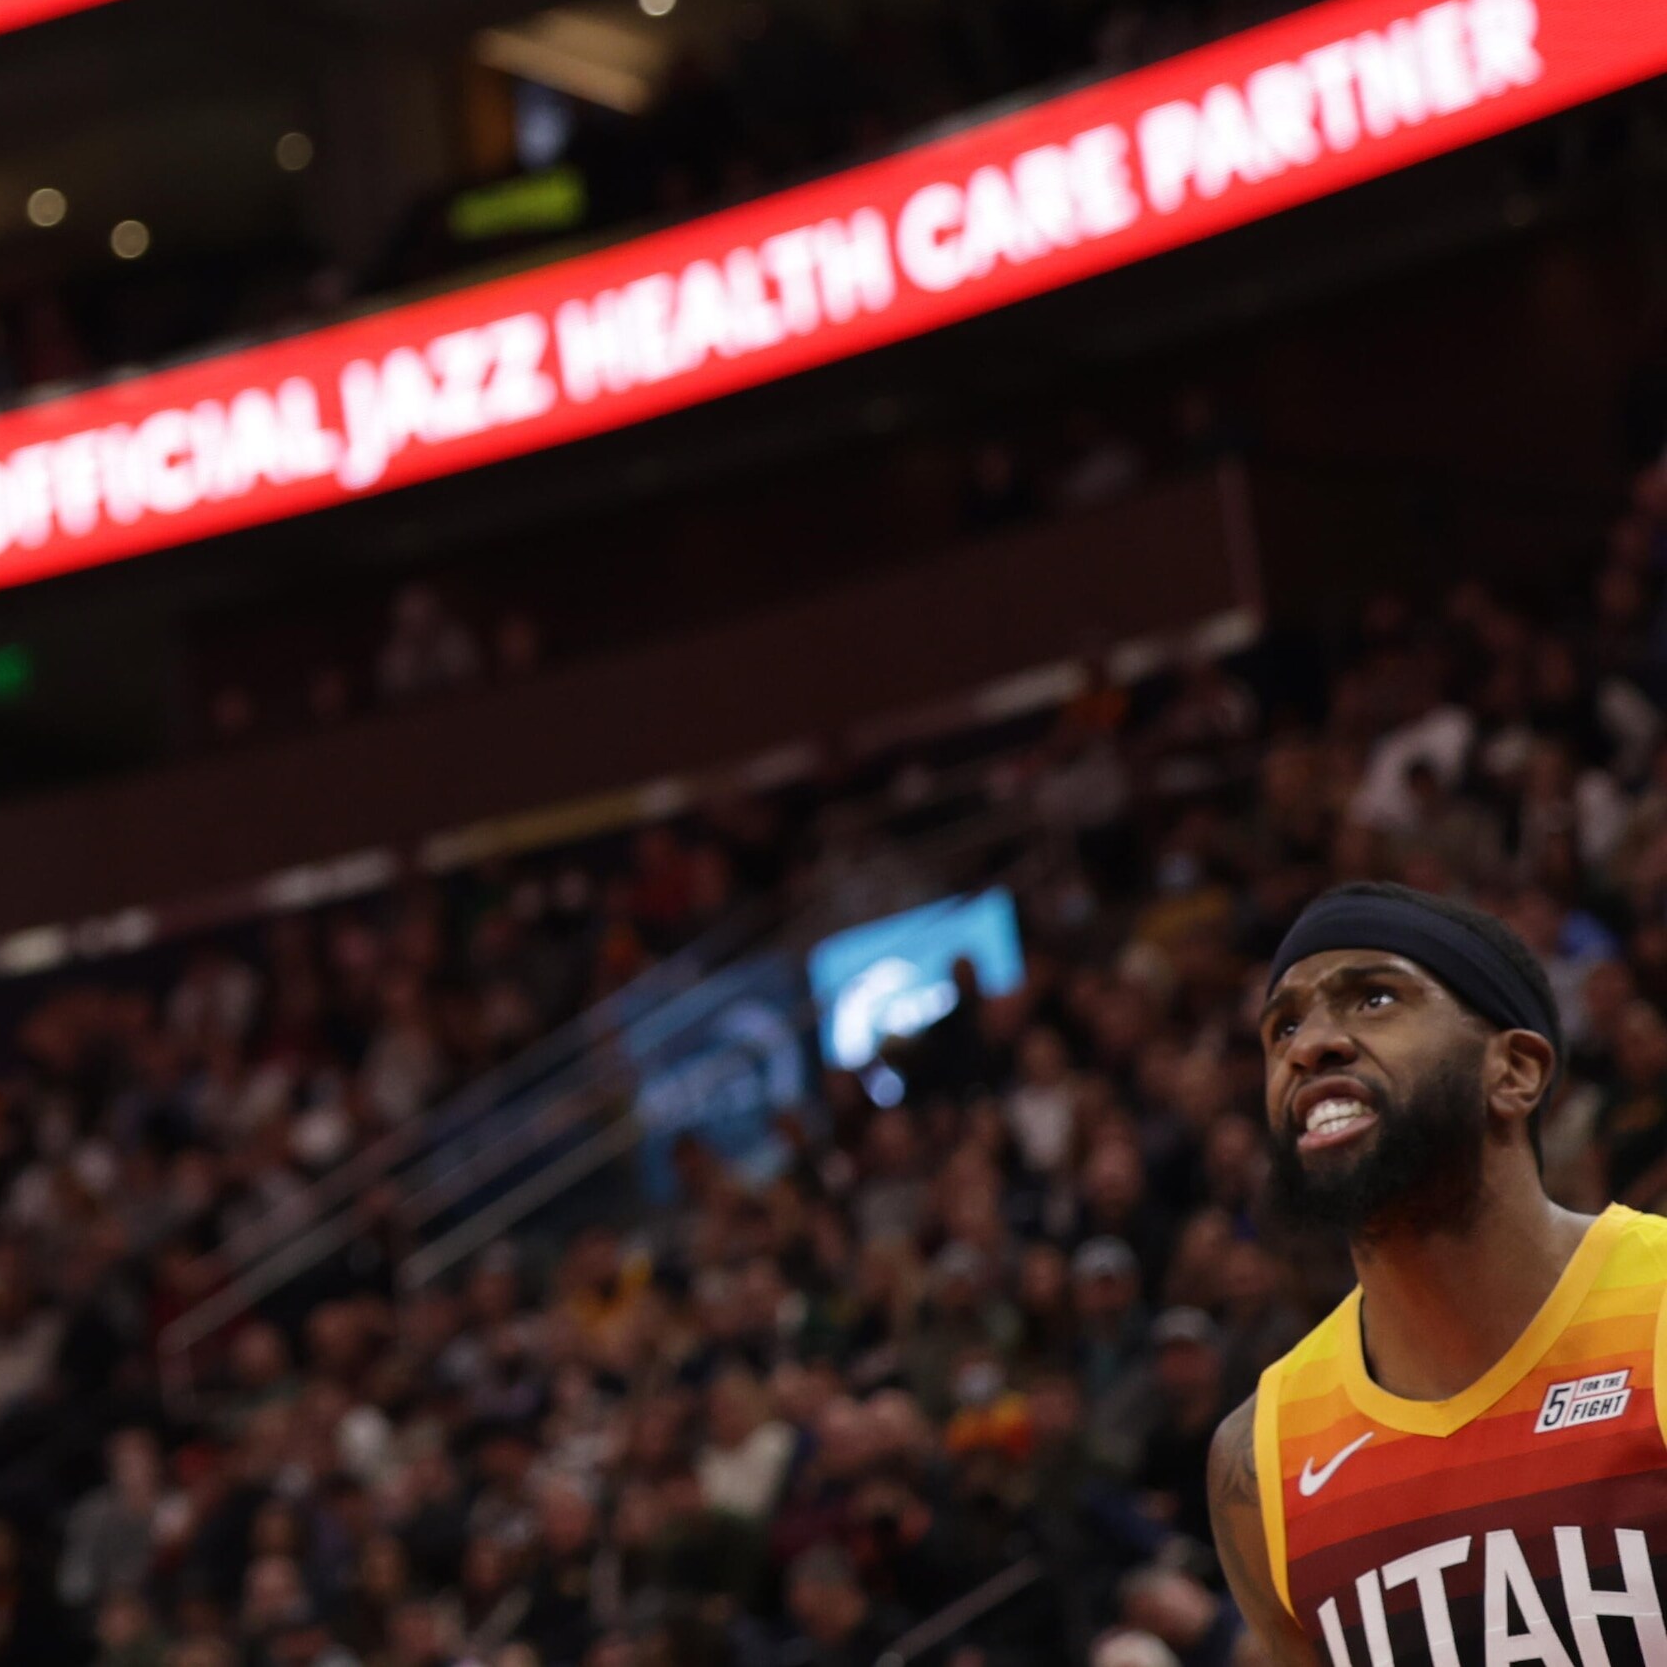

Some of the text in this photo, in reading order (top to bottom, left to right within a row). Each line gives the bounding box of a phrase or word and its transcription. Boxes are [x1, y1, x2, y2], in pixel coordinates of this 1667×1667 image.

[337, 312, 556, 489] JAZZ
[555, 209, 895, 402] HEALTH
[896, 124, 1139, 293] CARE
[1581, 1375, 1623, 1394] FOR THE
[1543, 1387, 1571, 1427] 5
[1570, 1395, 1624, 1422] FIGHT
[1317, 1525, 1667, 1667] UTAH
